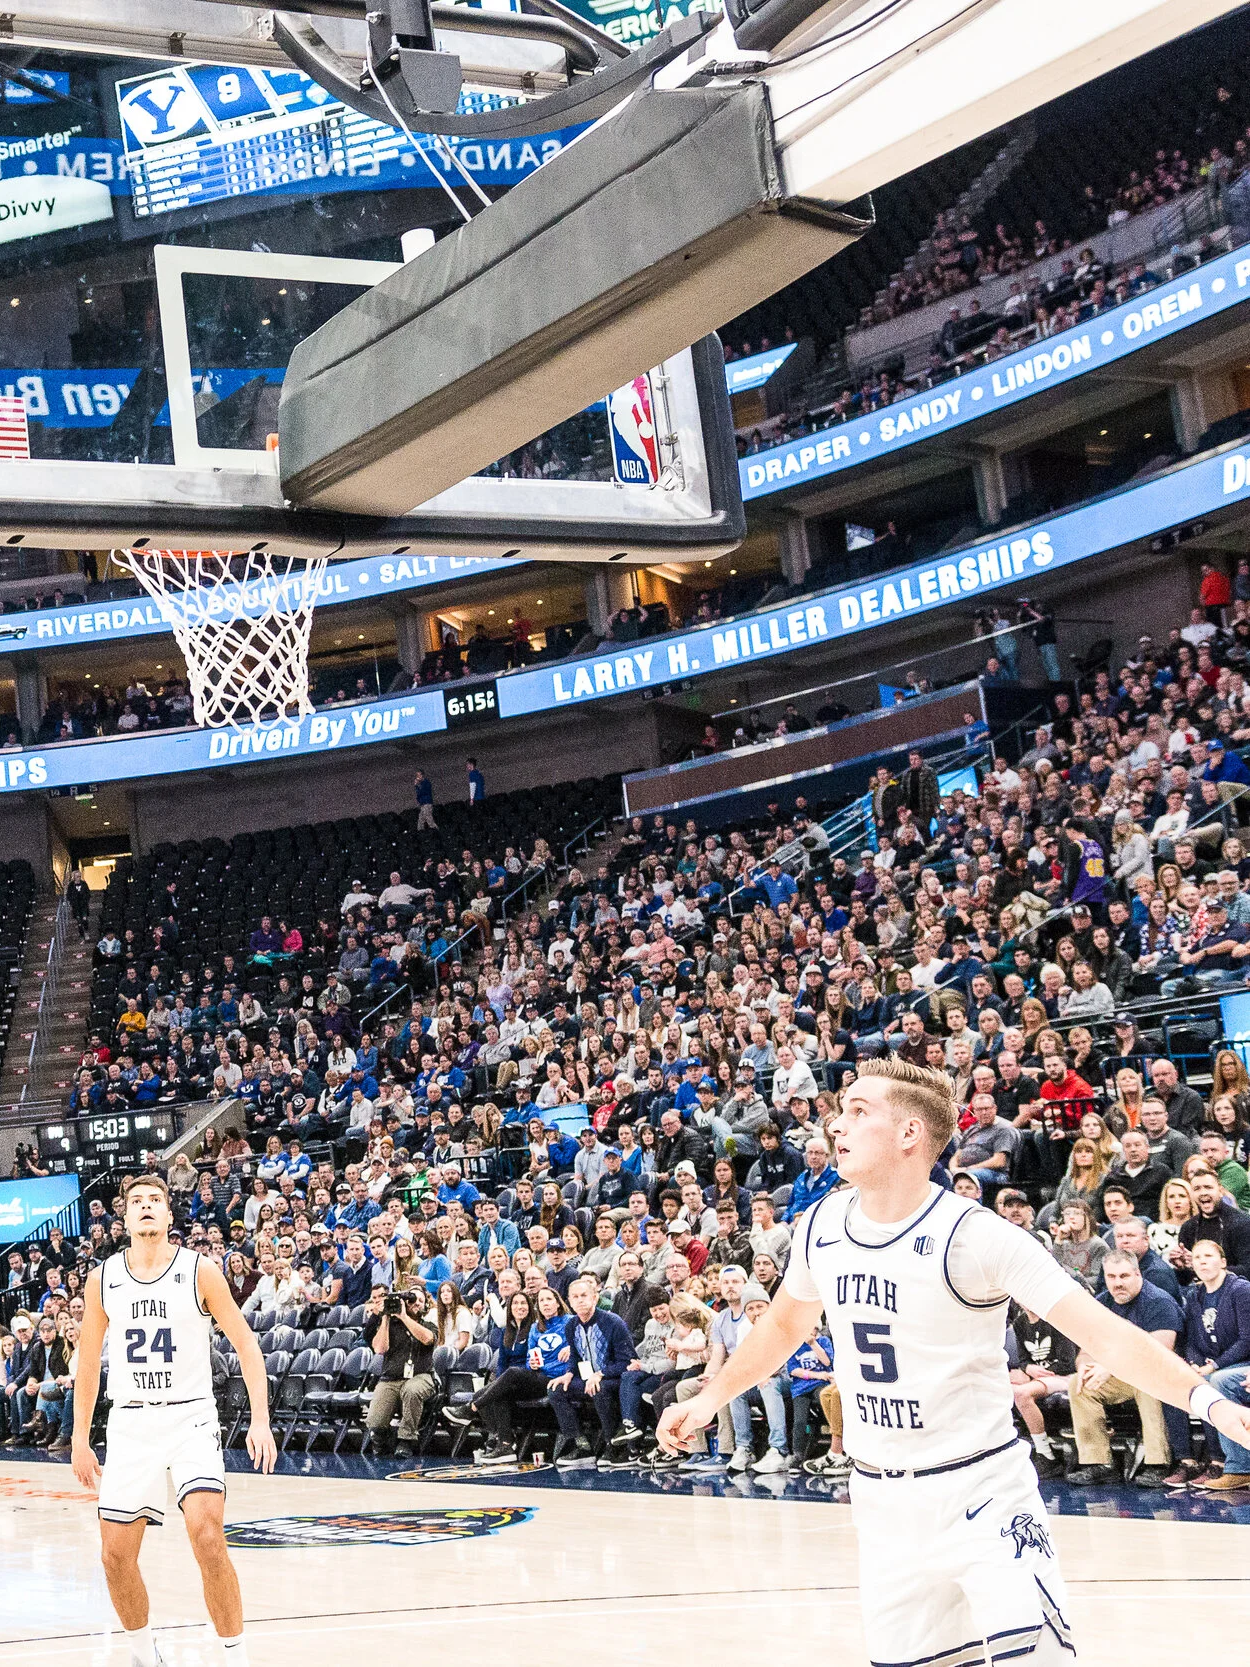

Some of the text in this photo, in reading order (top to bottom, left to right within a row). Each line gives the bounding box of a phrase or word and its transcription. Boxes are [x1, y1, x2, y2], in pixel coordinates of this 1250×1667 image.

[217, 73, 241, 104] 9
[129, 85, 186, 135] Y
[748, 283, 1203, 488] DRAPER SANDY LINDON OREM
[621, 459, 644, 480] NBA
[379, 556, 438, 584] SALT
[553, 531, 1054, 702] LARRY H. MILLER DEALERSHIPS
[447, 692, 486, 715] 6:15
[209, 723, 301, 760] Driven
[309, 715, 347, 748] By
[89, 1117, 129, 1140] 15:03
[156, 1128, 166, 1141] 4
[60, 1138, 70, 1152] 9
[96, 1142, 119, 1152] PERIOD
[837, 1273, 898, 1314] UTAH
[131, 1299, 167, 1319] UTAH
[125, 1327, 177, 1363] 24
[852, 1322, 898, 1383] 5
[133, 1371, 172, 1389] STATE
[856, 1393, 924, 1429] STATE
